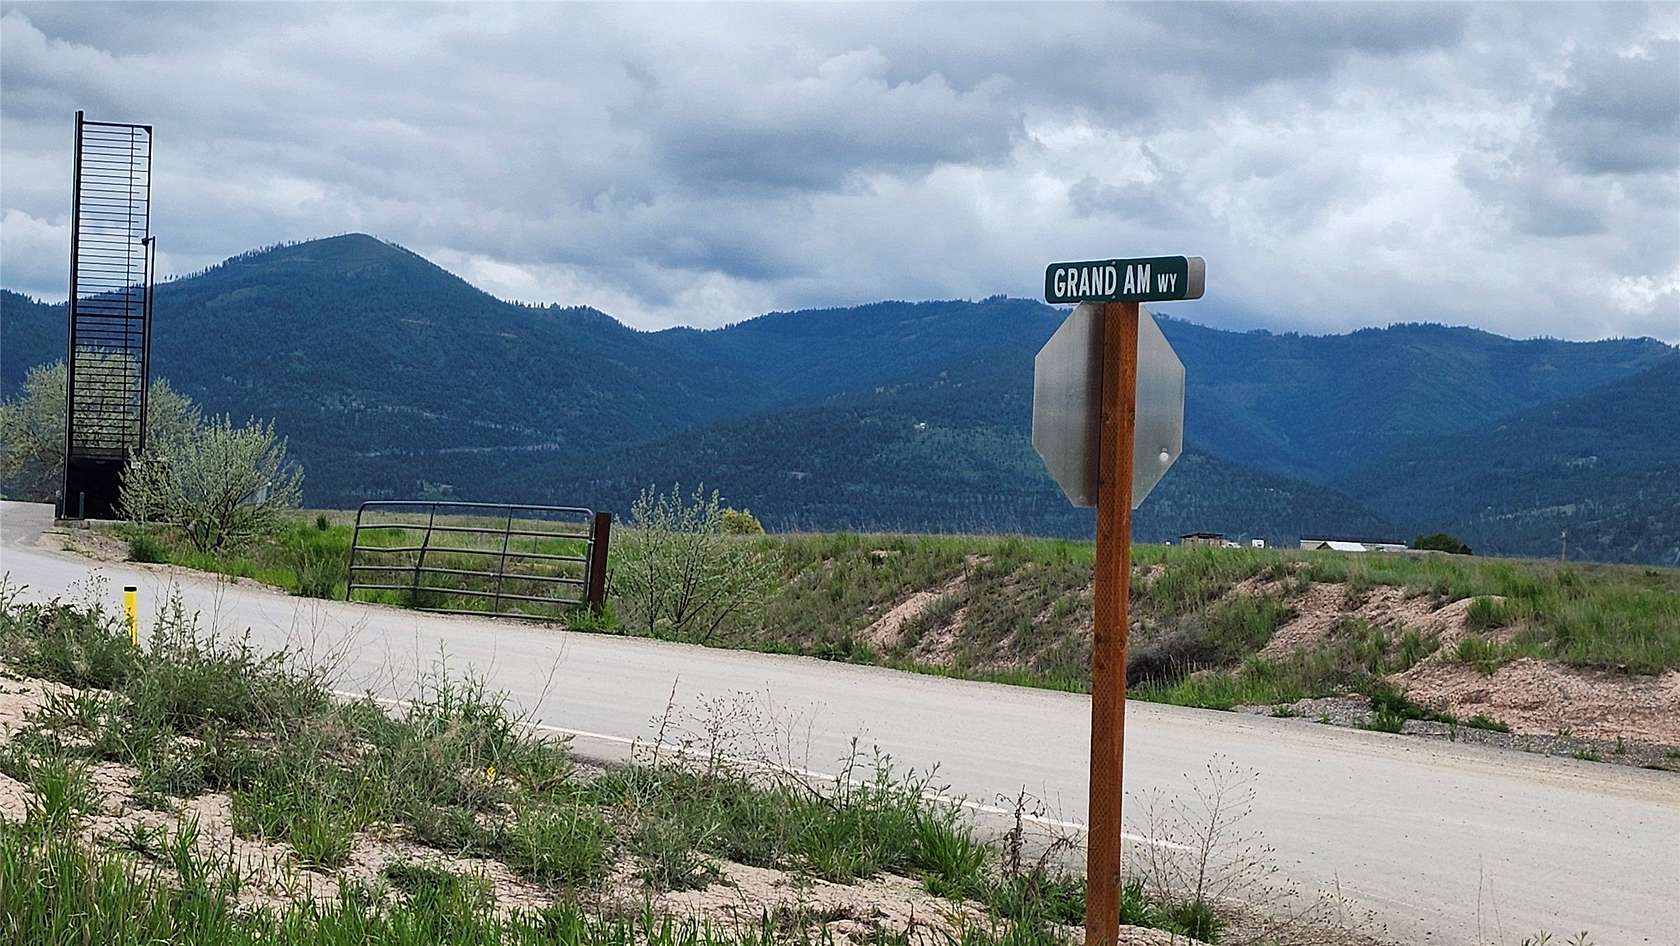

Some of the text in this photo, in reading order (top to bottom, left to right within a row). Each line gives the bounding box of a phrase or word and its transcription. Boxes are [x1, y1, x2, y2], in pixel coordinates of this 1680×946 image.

[1054, 263, 1178, 298] GRAND AM WY
